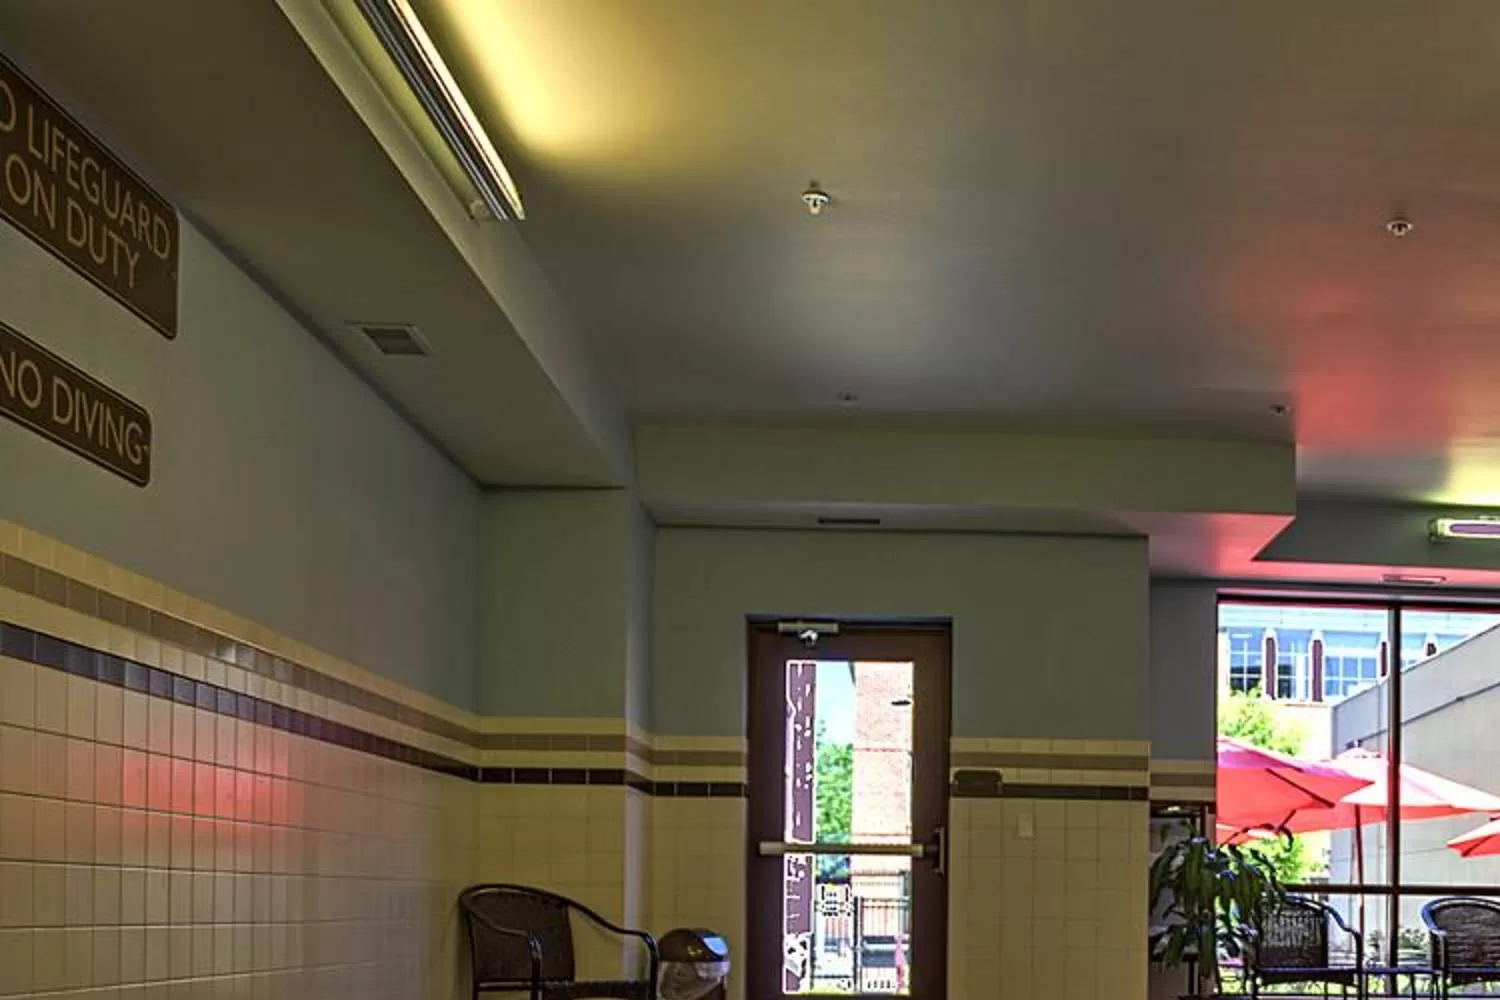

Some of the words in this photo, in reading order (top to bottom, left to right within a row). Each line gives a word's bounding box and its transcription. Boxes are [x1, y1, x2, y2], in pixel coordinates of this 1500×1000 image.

[0, 79, 17, 132] O
[27, 103, 171, 260] LIFEGUARD
[5, 153, 56, 230] ON
[66, 195, 140, 288] DUTY
[0, 350, 42, 409] NO
[52, 374, 144, 465] DIVING
